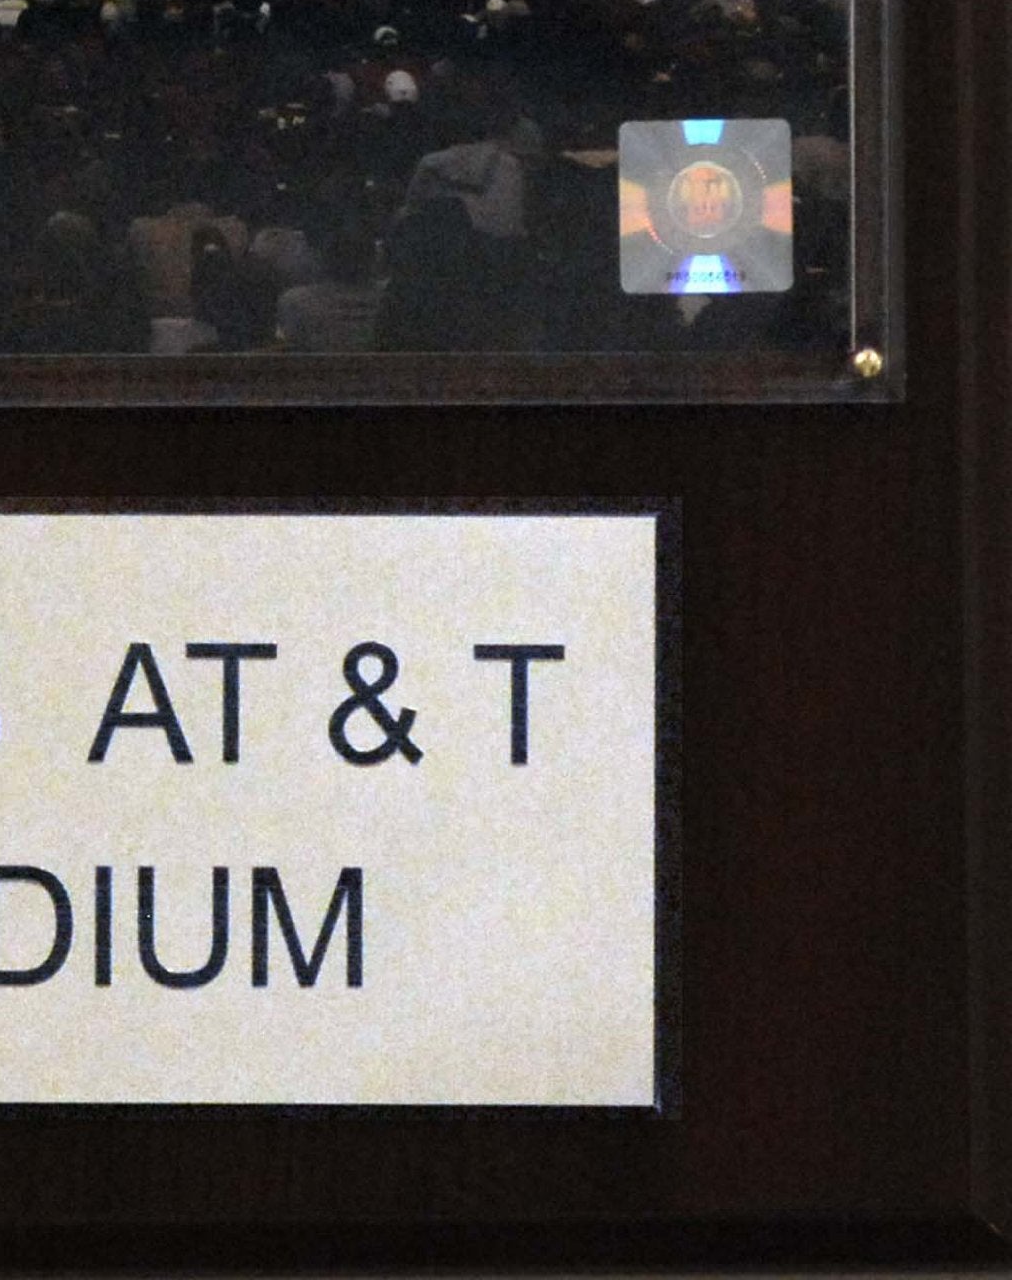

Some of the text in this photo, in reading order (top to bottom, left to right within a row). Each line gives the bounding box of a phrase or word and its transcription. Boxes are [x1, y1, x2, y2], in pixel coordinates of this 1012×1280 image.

[87, 641, 278, 765] AT
[328, 641, 425, 767] &
[473, 643, 565, 765] T
